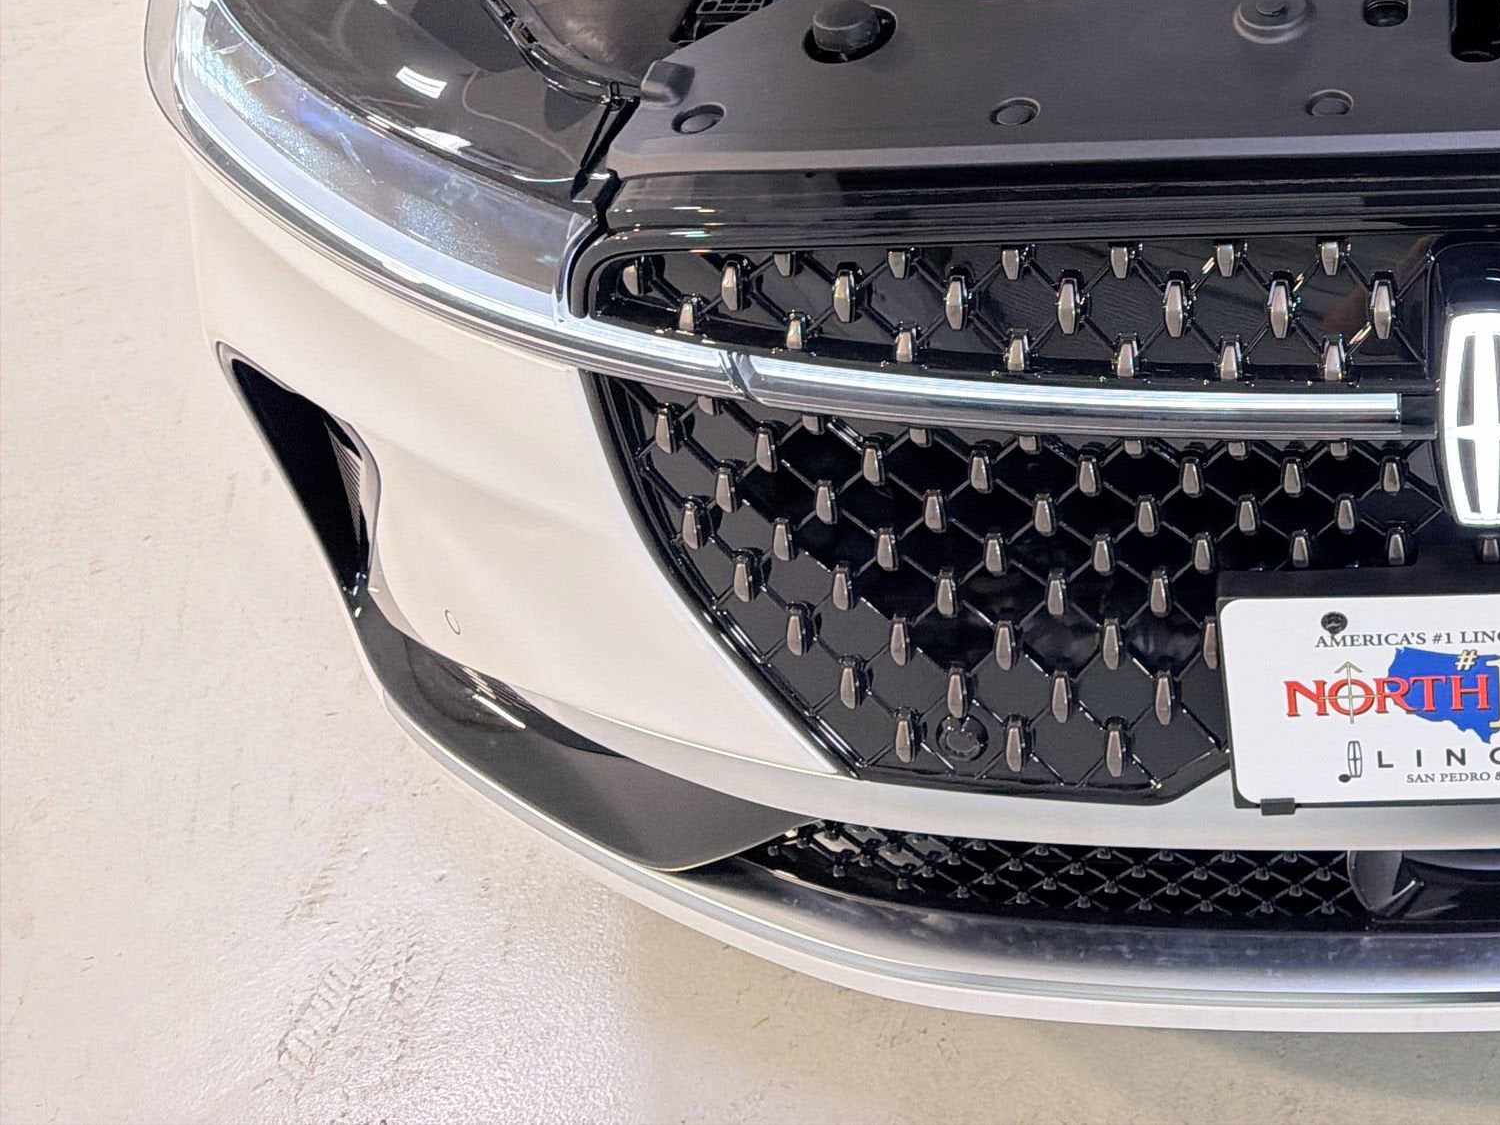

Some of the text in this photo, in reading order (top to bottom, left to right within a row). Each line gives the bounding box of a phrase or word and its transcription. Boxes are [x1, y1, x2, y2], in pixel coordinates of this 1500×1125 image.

[1315, 632, 1426, 648] AMERICA'S
[1432, 632, 1453, 644] #1
[1283, 674, 1491, 717] NORTH
[1406, 772, 1436, 783] SAN
[1440, 771, 1491, 782] PEDRO
